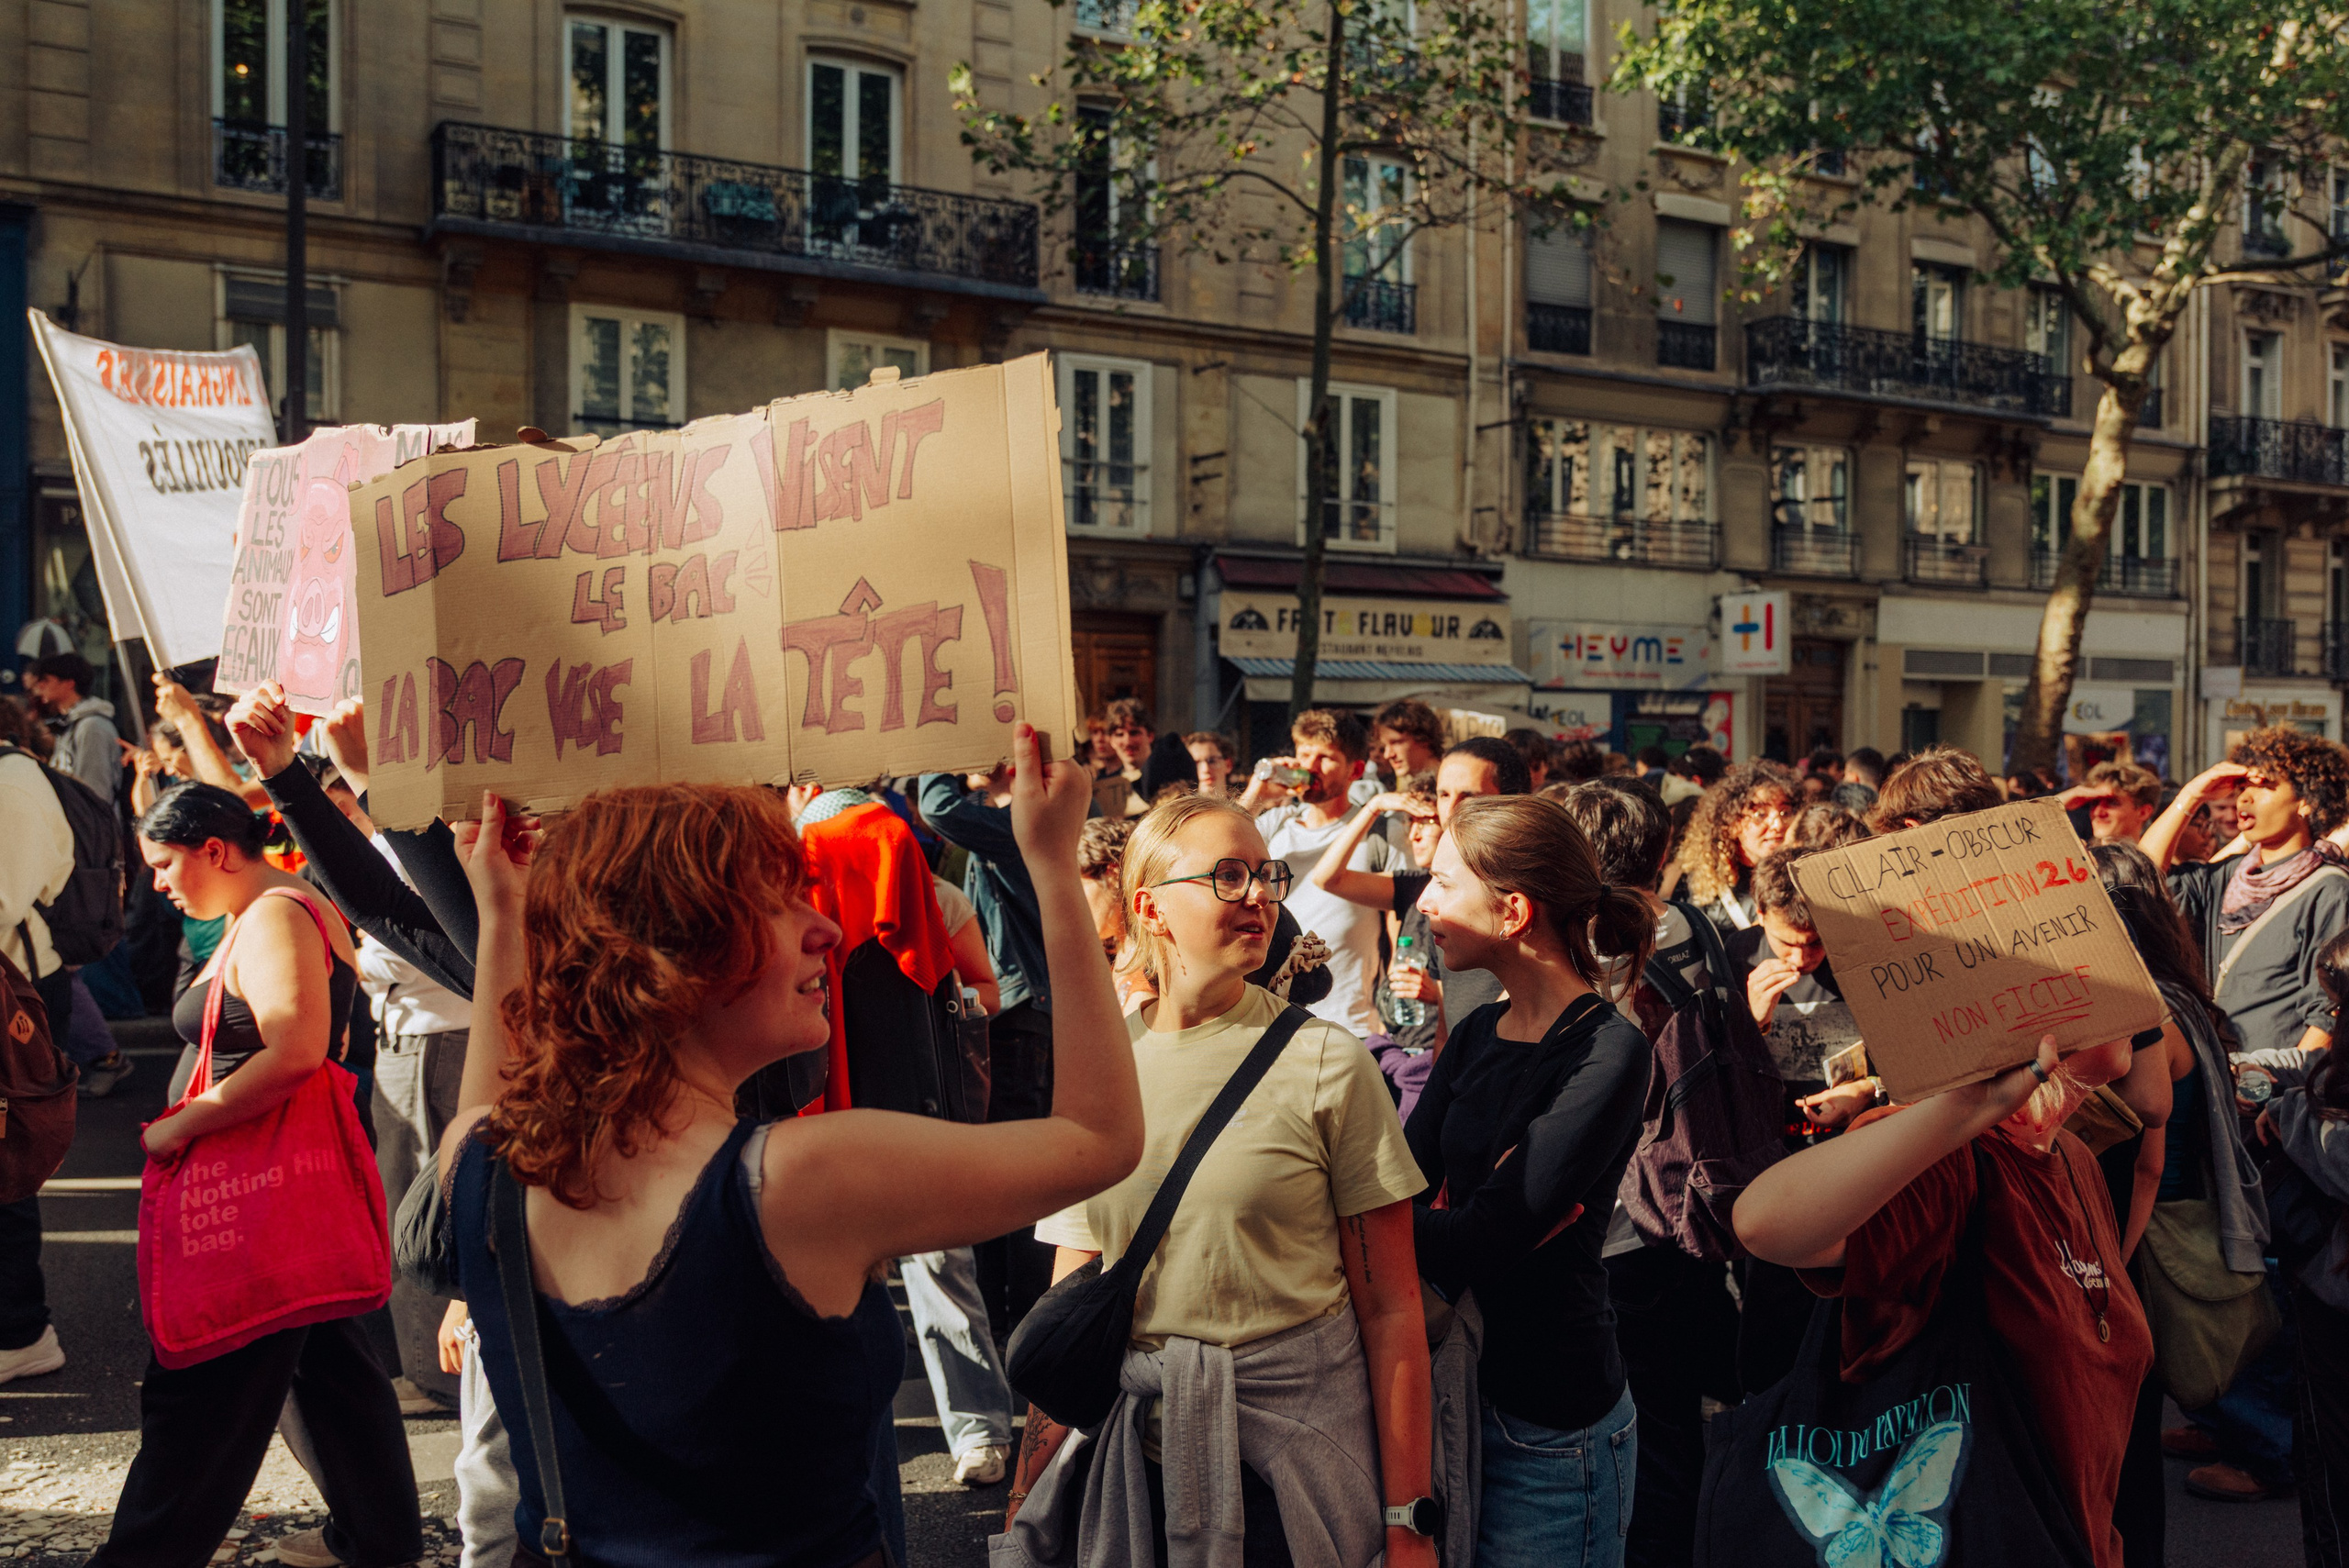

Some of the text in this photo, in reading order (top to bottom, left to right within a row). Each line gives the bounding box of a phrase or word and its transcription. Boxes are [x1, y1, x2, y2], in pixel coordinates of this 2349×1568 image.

[250, 510, 287, 549] LES
[376, 467, 468, 596] LES
[238, 589, 283, 624] SONT
[571, 550, 739, 633] LE BAC
[1559, 634, 1684, 664] HEYME
[377, 671, 419, 765] LA
[426, 657, 526, 771] BAC
[690, 635, 765, 744] LA
[1881, 869, 2040, 942] EXPÉDITION
[1871, 905, 2099, 999] POUR UN AVENIR
[1932, 965, 2090, 1044] NON FICTIF
[180, 1149, 337, 1211] Notting Hill
[184, 1161, 228, 1187] the
[180, 1205, 239, 1233] tote
[1765, 1426, 1787, 1470] LA
[1797, 1424, 1842, 1467] LOI
[1848, 1426, 1871, 1466] DU
